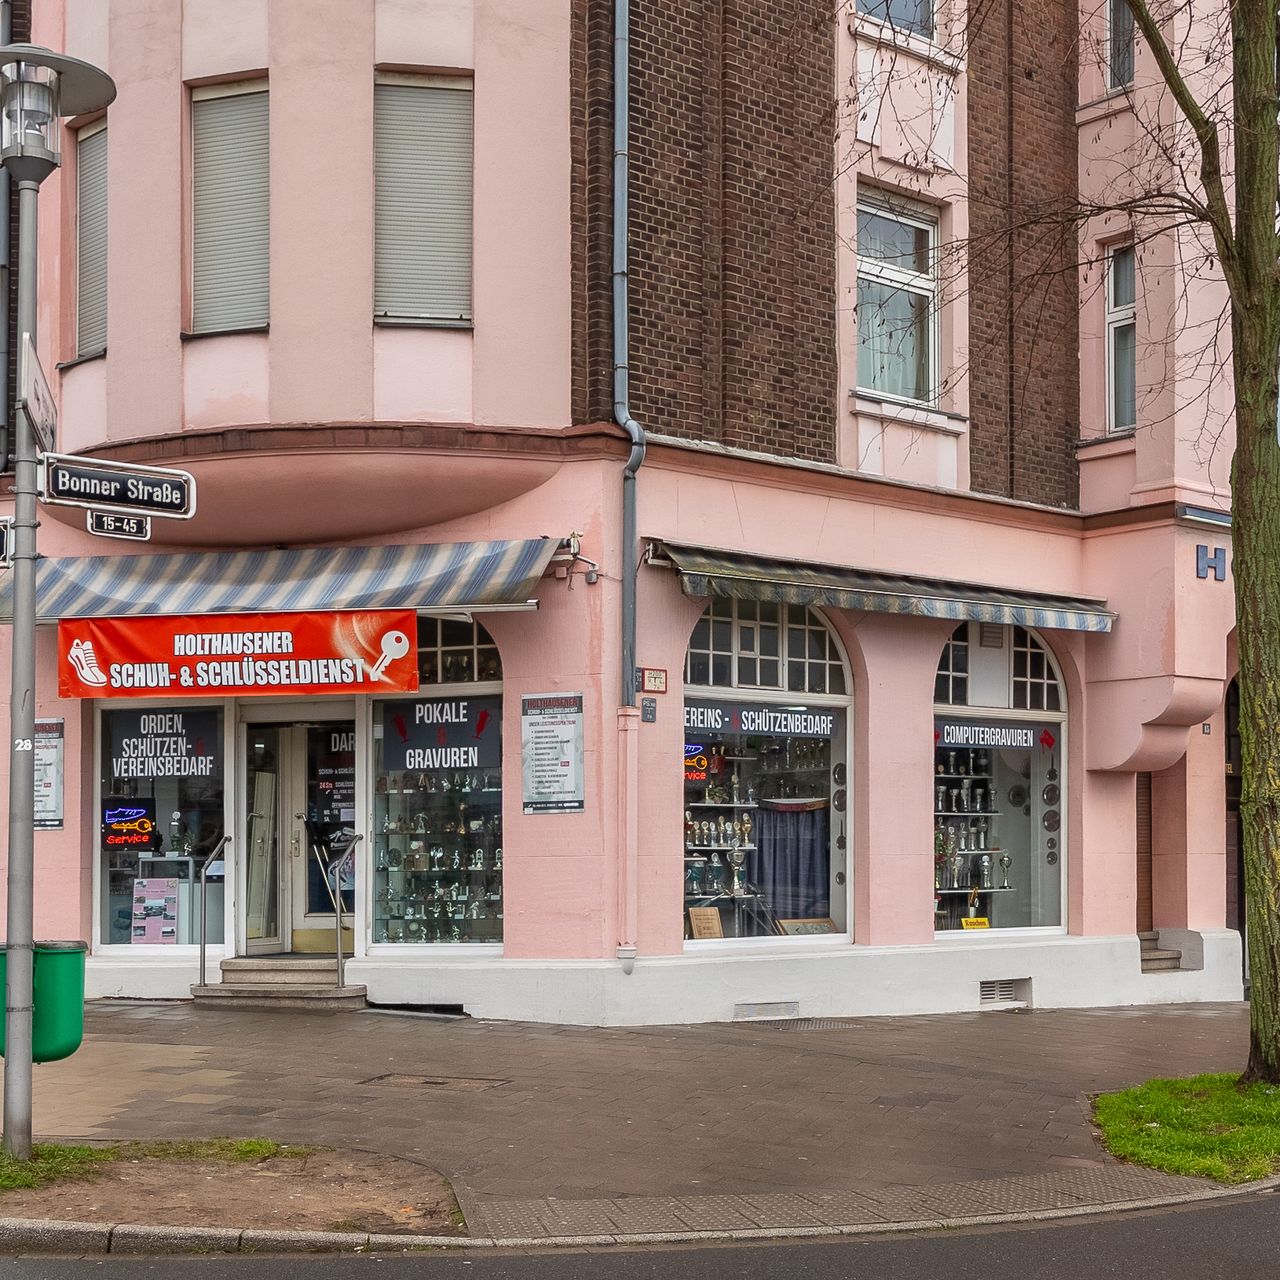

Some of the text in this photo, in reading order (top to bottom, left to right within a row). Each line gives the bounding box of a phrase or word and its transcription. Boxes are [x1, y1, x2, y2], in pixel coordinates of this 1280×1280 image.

[58, 471, 181, 505] Bonner Straße
[102, 516, 138, 533] 15-45
[174, 631, 293, 657] HOLTHAUSENER
[110, 658, 365, 689] SCHUH- & SCHLÜSSELDIENST
[140, 713, 186, 736] ORDEN,
[415, 702, 468, 724] POKALE
[741, 709, 833, 735] SCHÜTZENBEDARF
[14, 738, 33, 751] 28
[121, 735, 192, 756] SCHÜTZEN-
[944, 725, 1034, 747] COMPUTERGRAVUREN
[112, 755, 214, 778] VEREINSBEDARF
[405, 747, 478, 770] GRAVUREN
[106, 833, 150, 845] Service
